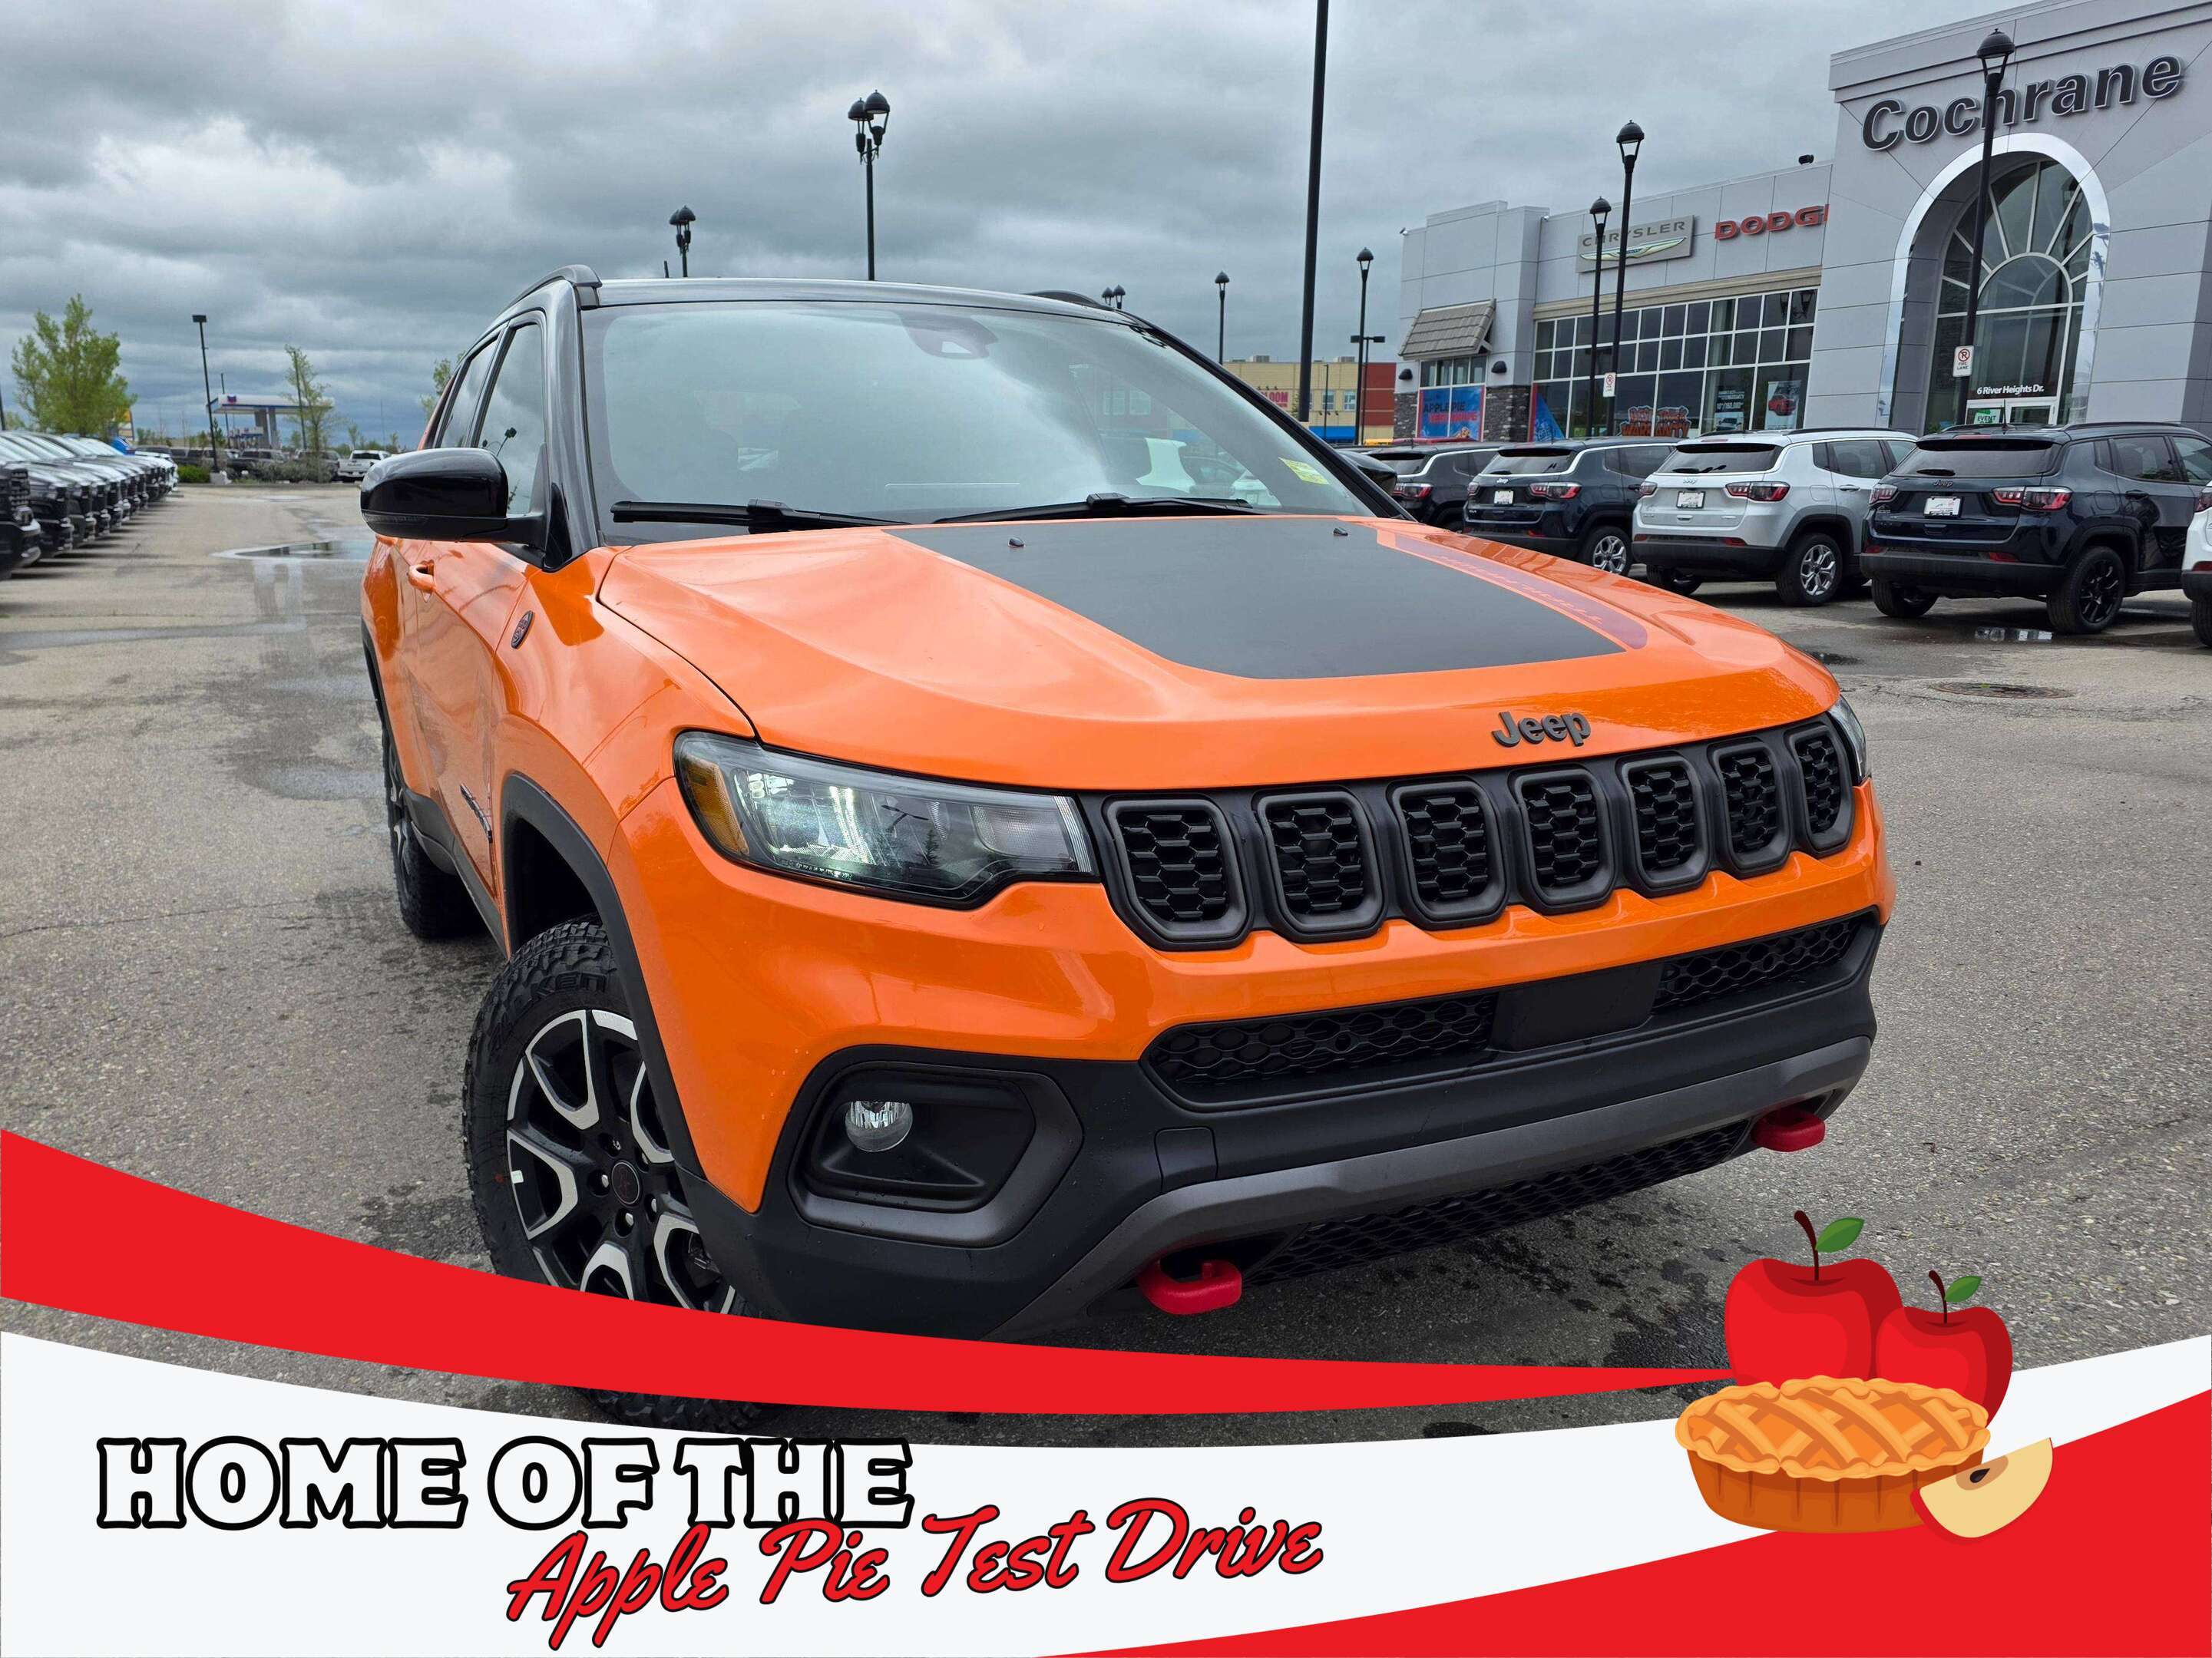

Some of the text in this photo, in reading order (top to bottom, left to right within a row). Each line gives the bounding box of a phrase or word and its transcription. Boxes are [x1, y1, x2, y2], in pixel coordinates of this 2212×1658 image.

[1862, 54, 2187, 150] Cochrane
[1582, 221, 1685, 246] CHRSLER
[1714, 204, 1830, 240] DODG
[1976, 384, 2045, 395] 6 River Heights Dr.
[1491, 711, 1592, 748] Jeep
